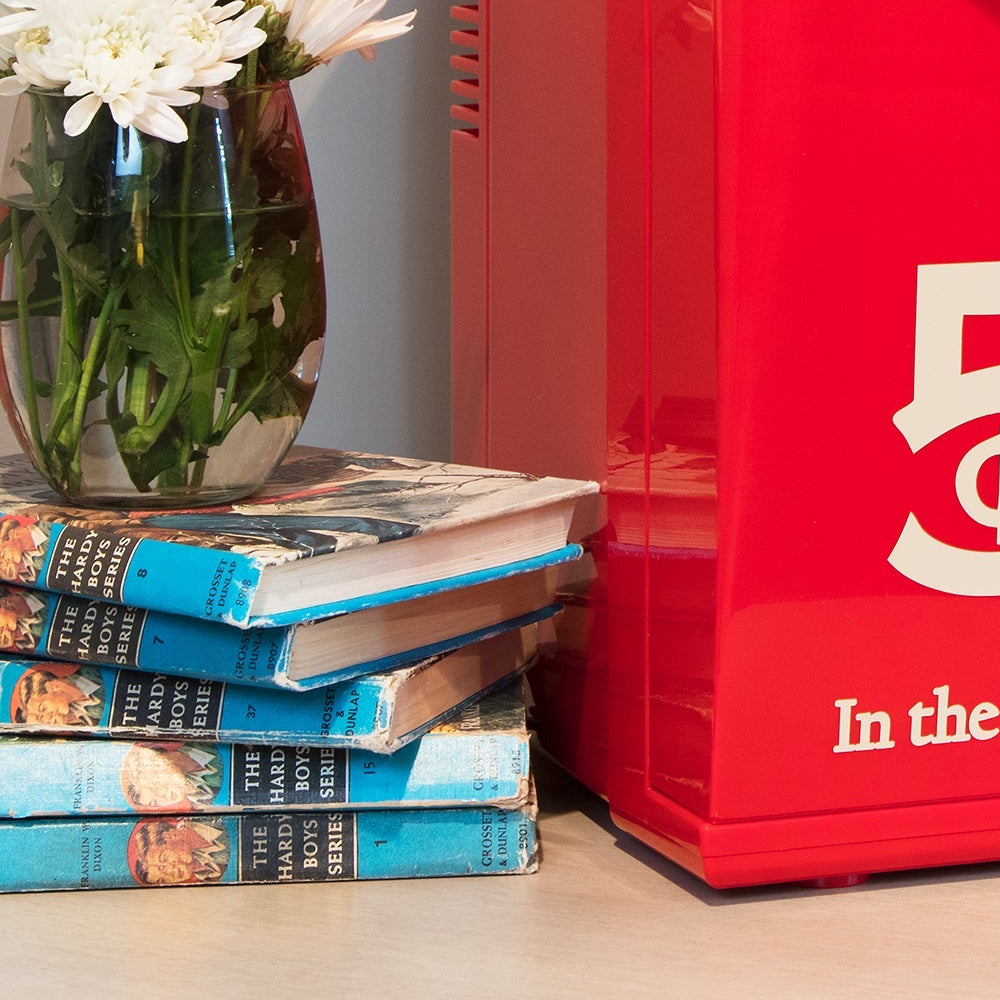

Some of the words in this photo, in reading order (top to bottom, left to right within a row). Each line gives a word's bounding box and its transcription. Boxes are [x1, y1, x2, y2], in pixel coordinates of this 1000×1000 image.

[55, 538, 77, 579] THE
[71, 529, 99, 594] HARDY
[88, 539, 112, 588] BOYS
[103, 537, 131, 598] SERIES
[137, 568, 148, 578] 8
[205, 558, 228, 616] GROSSET
[217, 561, 238, 607] DUNLAP
[58, 606, 79, 647] THE
[97, 606, 118, 655] BOYS
[153, 636, 165, 645] 7
[248, 628, 264, 671] DUNLA
[235, 630, 251, 680] GROSSE
[267, 641, 278, 670] 8907
[122, 684, 141, 725] THE
[168, 680, 189, 734] BOYS
[247, 705, 256, 719] 37
[345, 689, 359, 737] DUNLAP
[832, 698, 895, 753] In
[908, 685, 1000, 747] the
[245, 751, 260, 792] THE
[270, 745, 285, 803] HARD
[295, 745, 310, 791] BOYS
[320, 748, 335, 799] SERIE
[363, 762, 376, 775] 15
[490, 783, 498, 791] &
[93, 838, 102, 872] DIXON
[252, 826, 268, 869] THE
[278, 813, 293, 880] HARDY
[303, 819, 318, 868] BOYS
[328, 812, 343, 875] SERIES
[481, 810, 493, 866] GROSSET
[497, 808, 507, 855] DUNLAP
[80, 837, 90, 888] FRANKLIN
